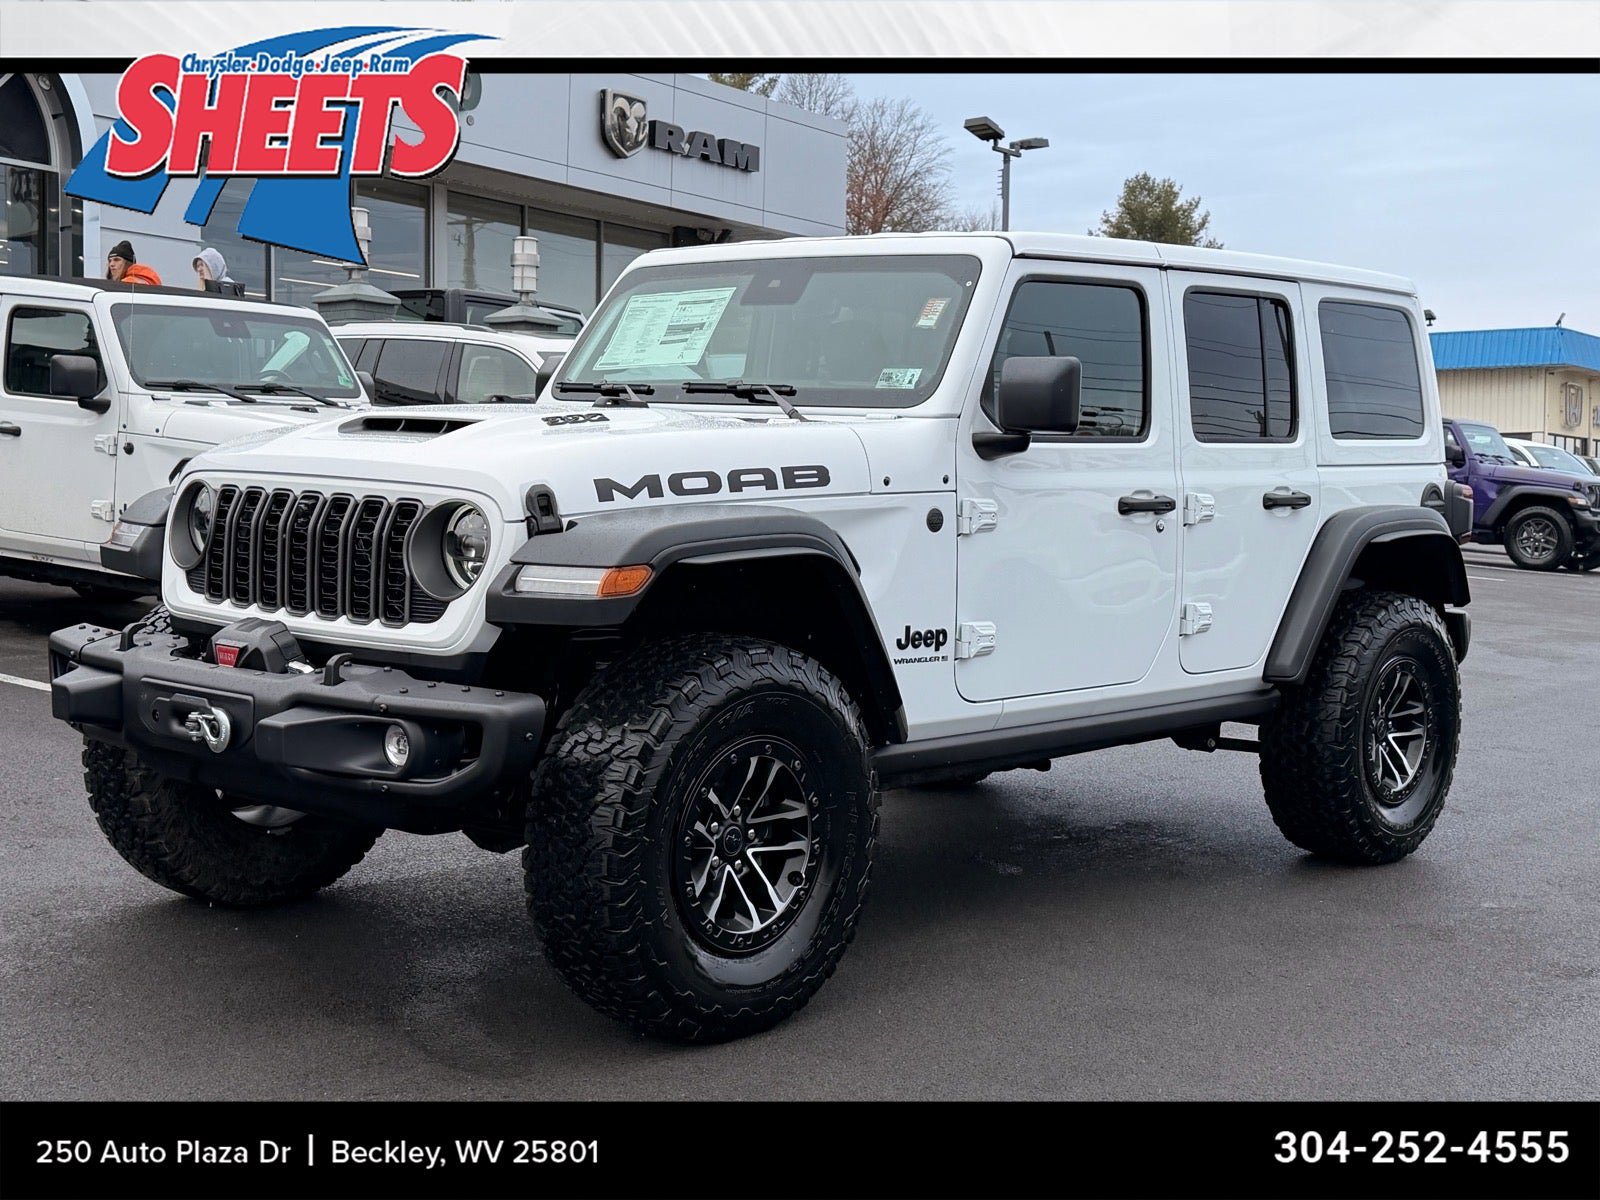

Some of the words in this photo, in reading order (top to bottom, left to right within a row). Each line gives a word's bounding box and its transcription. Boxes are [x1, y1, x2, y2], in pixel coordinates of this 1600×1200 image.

[648, 119, 760, 172] RAM
[593, 464, 831, 502] MOAB
[896, 625, 948, 652] Jeep
[893, 656, 940, 665] WRANGLER
